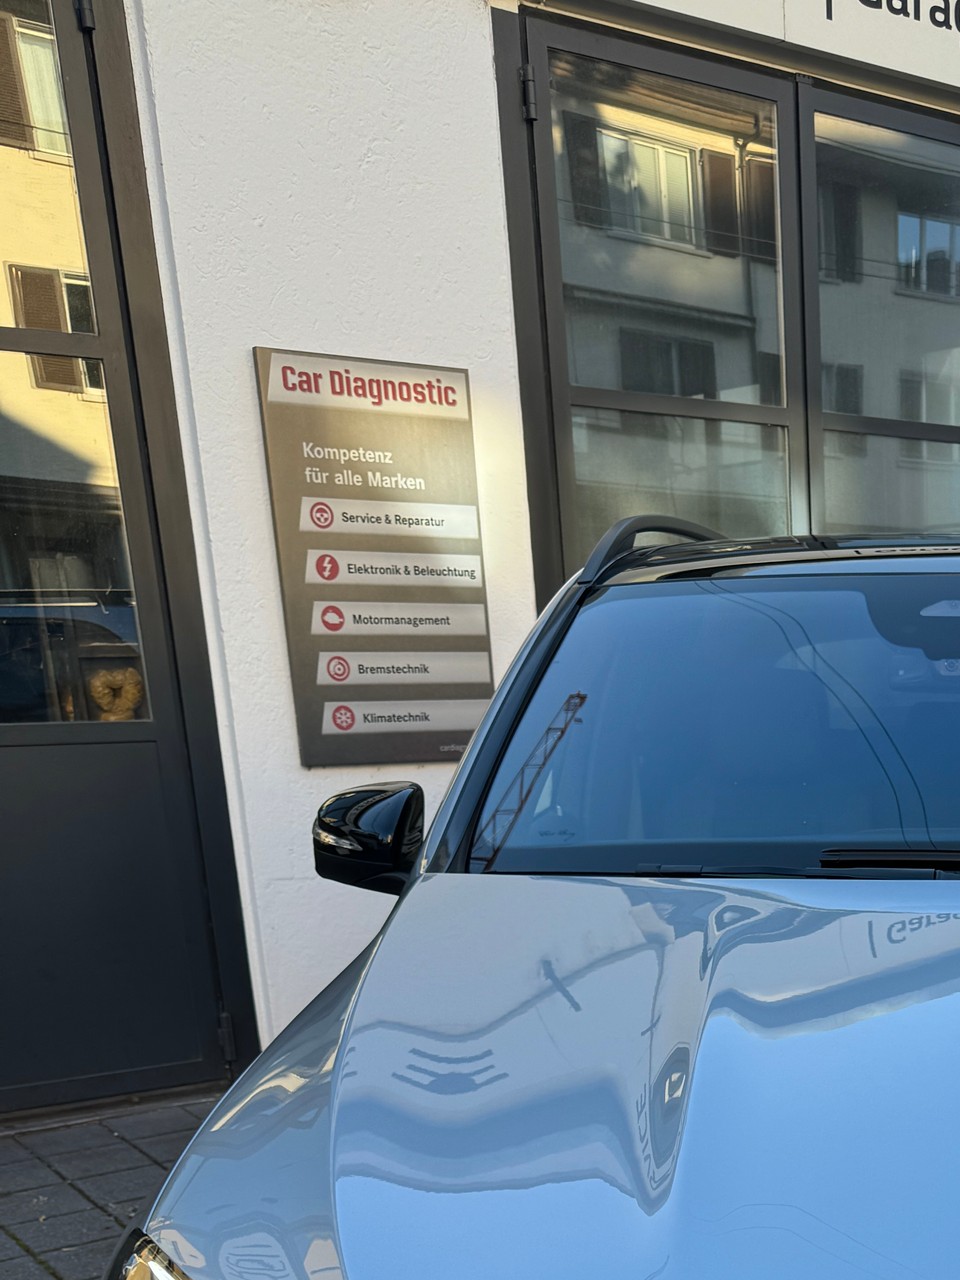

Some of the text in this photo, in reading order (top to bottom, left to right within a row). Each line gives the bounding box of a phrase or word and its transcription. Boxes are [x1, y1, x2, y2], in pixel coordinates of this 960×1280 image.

[281, 365, 457, 406] Car Diagnostic
[302, 442, 393, 464] Kompetenz
[304, 467, 426, 490] für alle Marken
[341, 512, 445, 528] Service & Reparatur
[347, 563, 476, 579] Elektronik & Beleuchtung
[352, 614, 451, 627] Motormanagement
[358, 664, 429, 675] Bremstechnik
[363, 712, 430, 723] Klimatechnik
